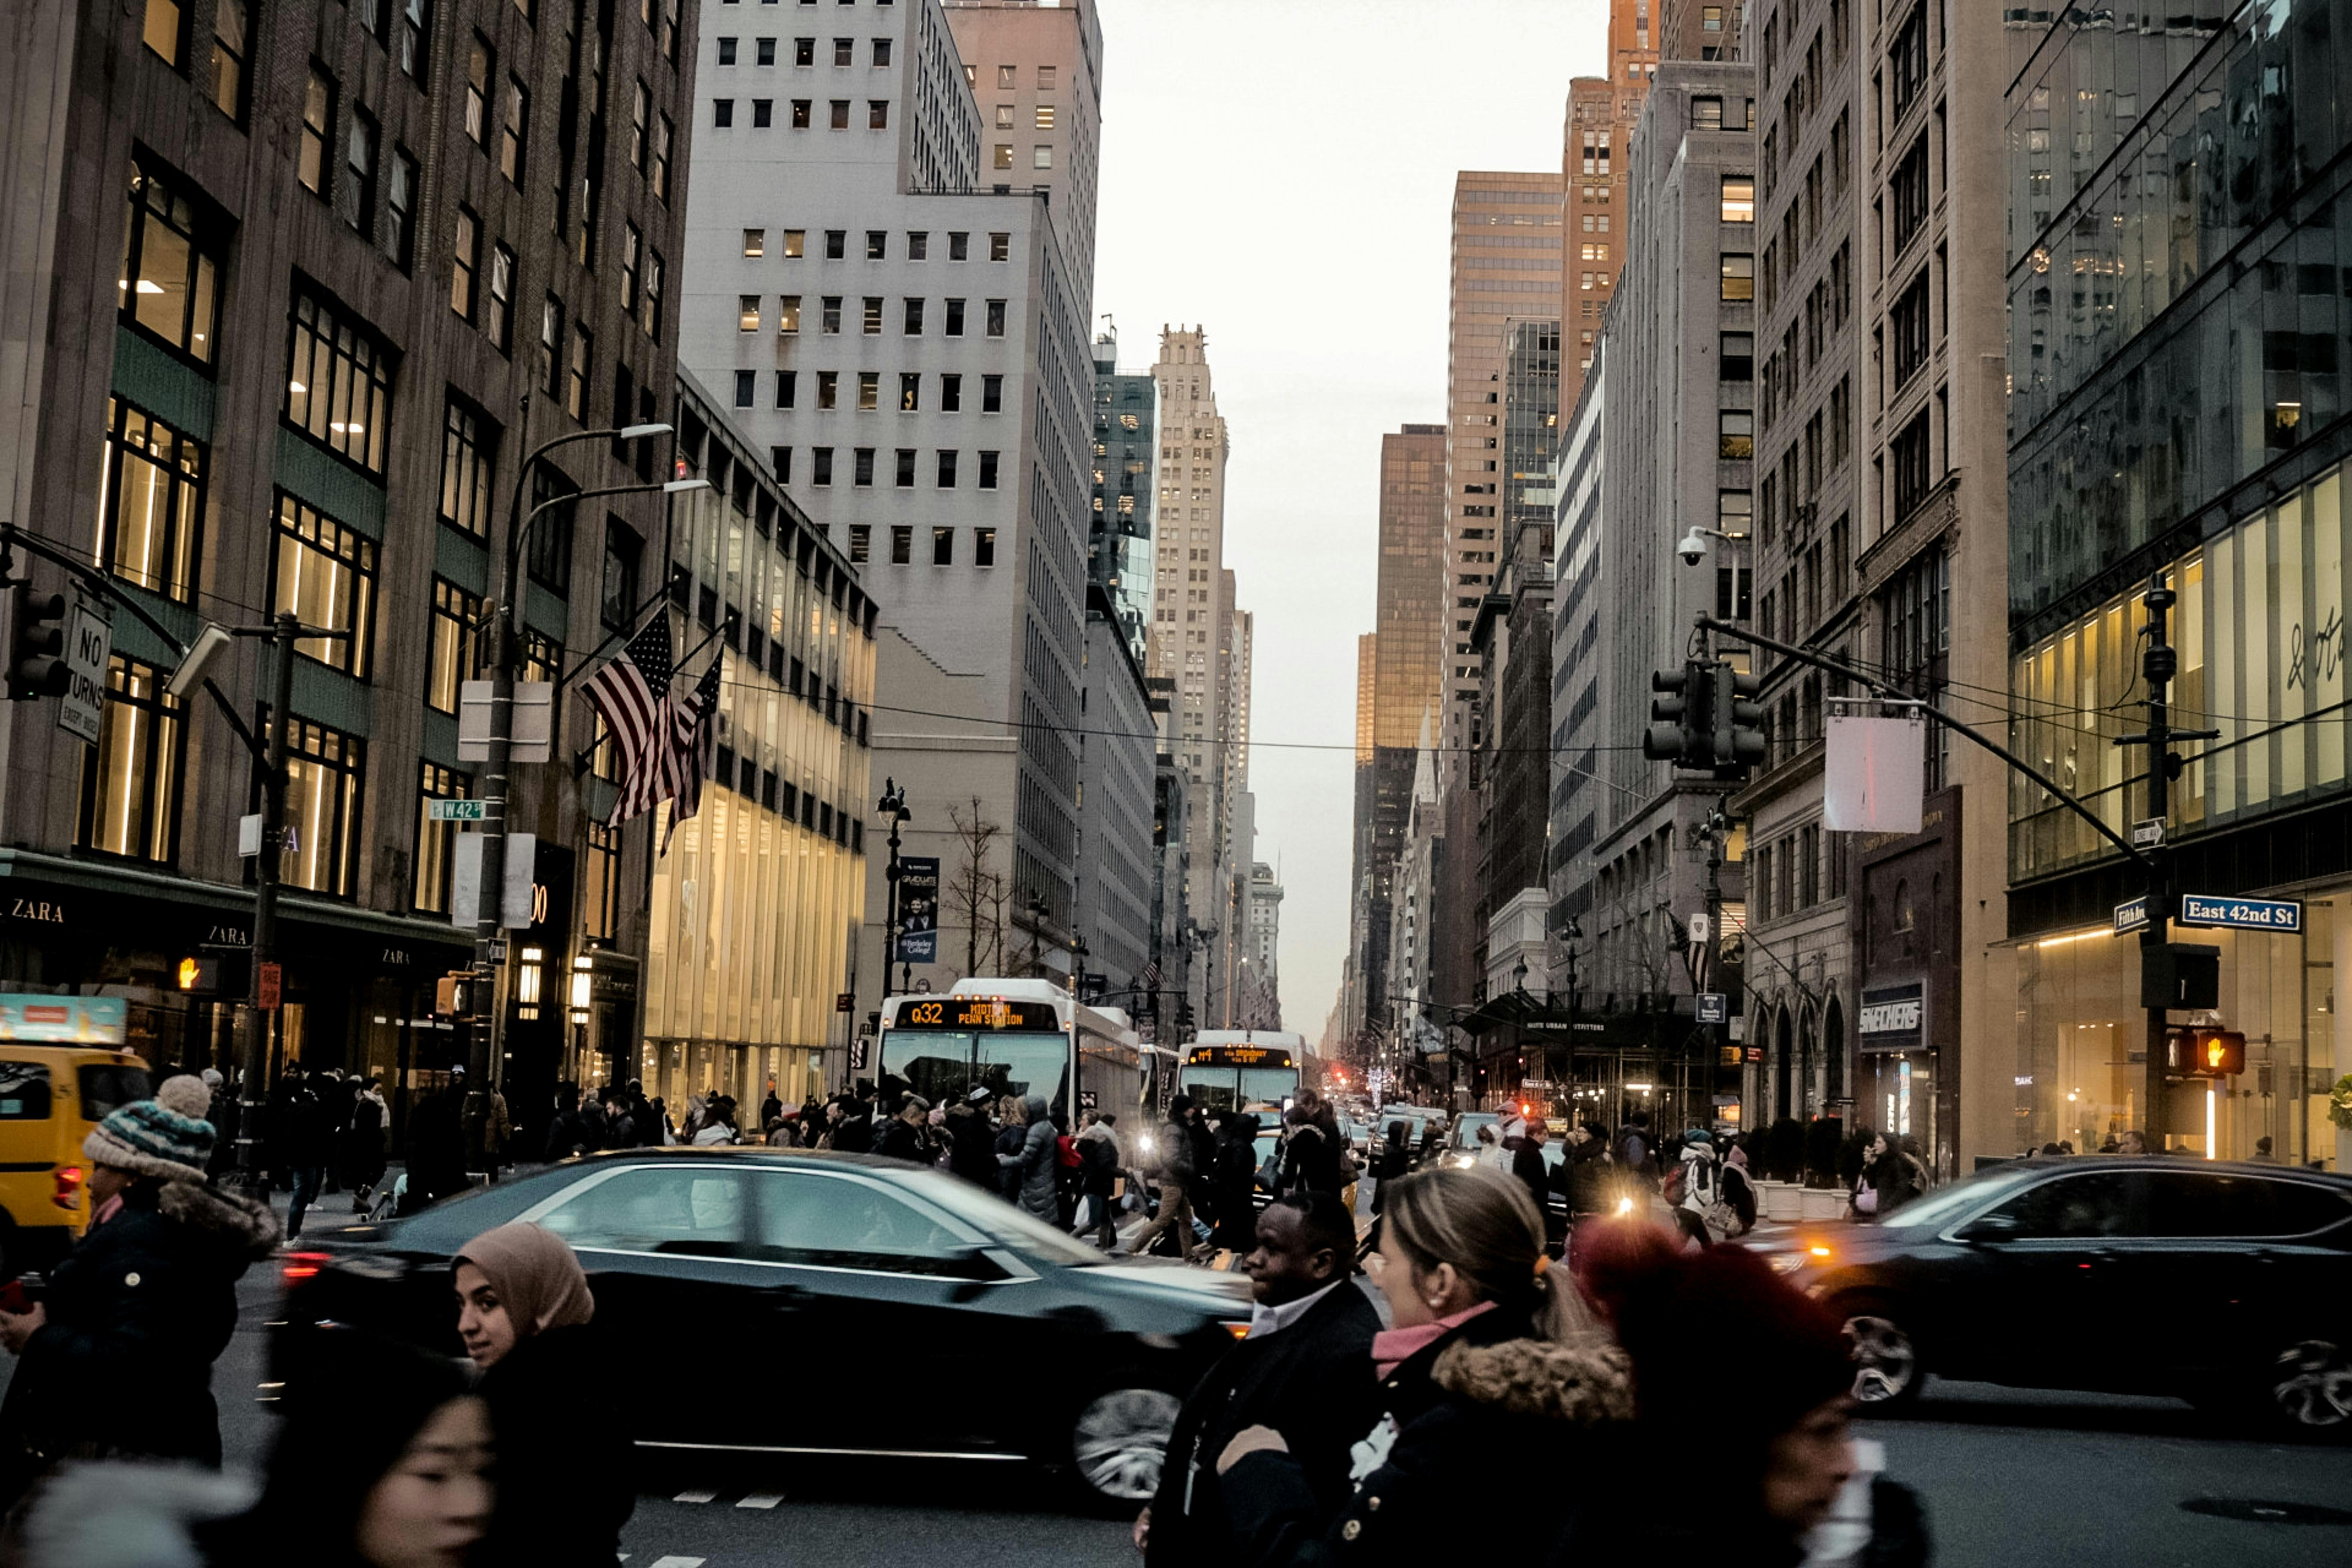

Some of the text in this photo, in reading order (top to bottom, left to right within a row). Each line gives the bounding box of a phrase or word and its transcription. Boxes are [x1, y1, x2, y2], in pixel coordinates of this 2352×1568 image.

[79, 627, 101, 667] NO
[73, 671, 103, 711] URNS
[445, 803, 455, 818] W
[456, 803, 472, 818] 42
[12, 898, 64, 923] ZARA
[2118, 907, 2135, 926] Fifth
[2188, 901, 2294, 924] East 42nd St
[209, 926, 246, 945] ZARA
[378, 949, 410, 965] ZARA
[912, 1003, 943, 1023] Q32
[958, 1014, 1022, 1025] PENN STATION
[1859, 1002, 1922, 1033] SKECHERS
[1199, 1048, 1212, 1062] M4
